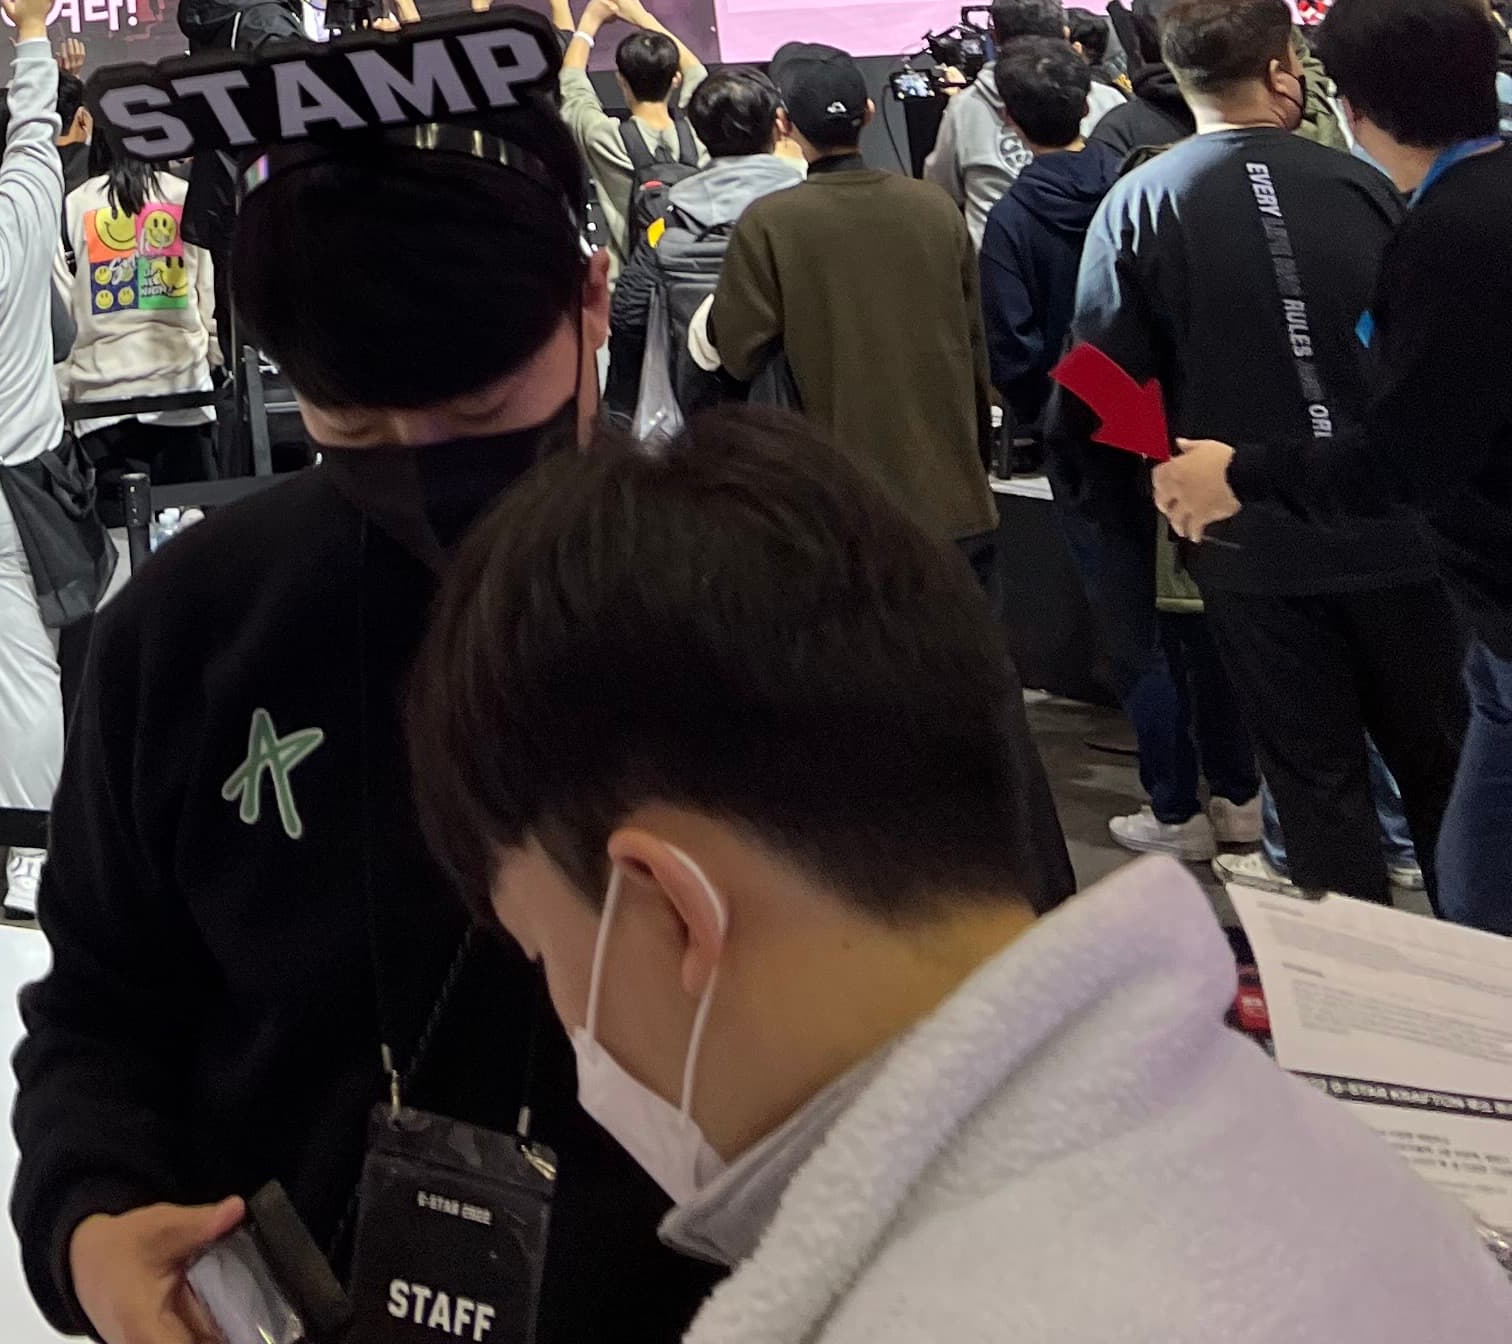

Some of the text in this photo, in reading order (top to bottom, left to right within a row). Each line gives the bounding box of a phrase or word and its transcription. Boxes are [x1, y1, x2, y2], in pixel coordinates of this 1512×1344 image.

[99, 28, 549, 159] STAMP
[1245, 162, 1283, 217] EVERY
[387, 1278, 496, 1342] STAFF
